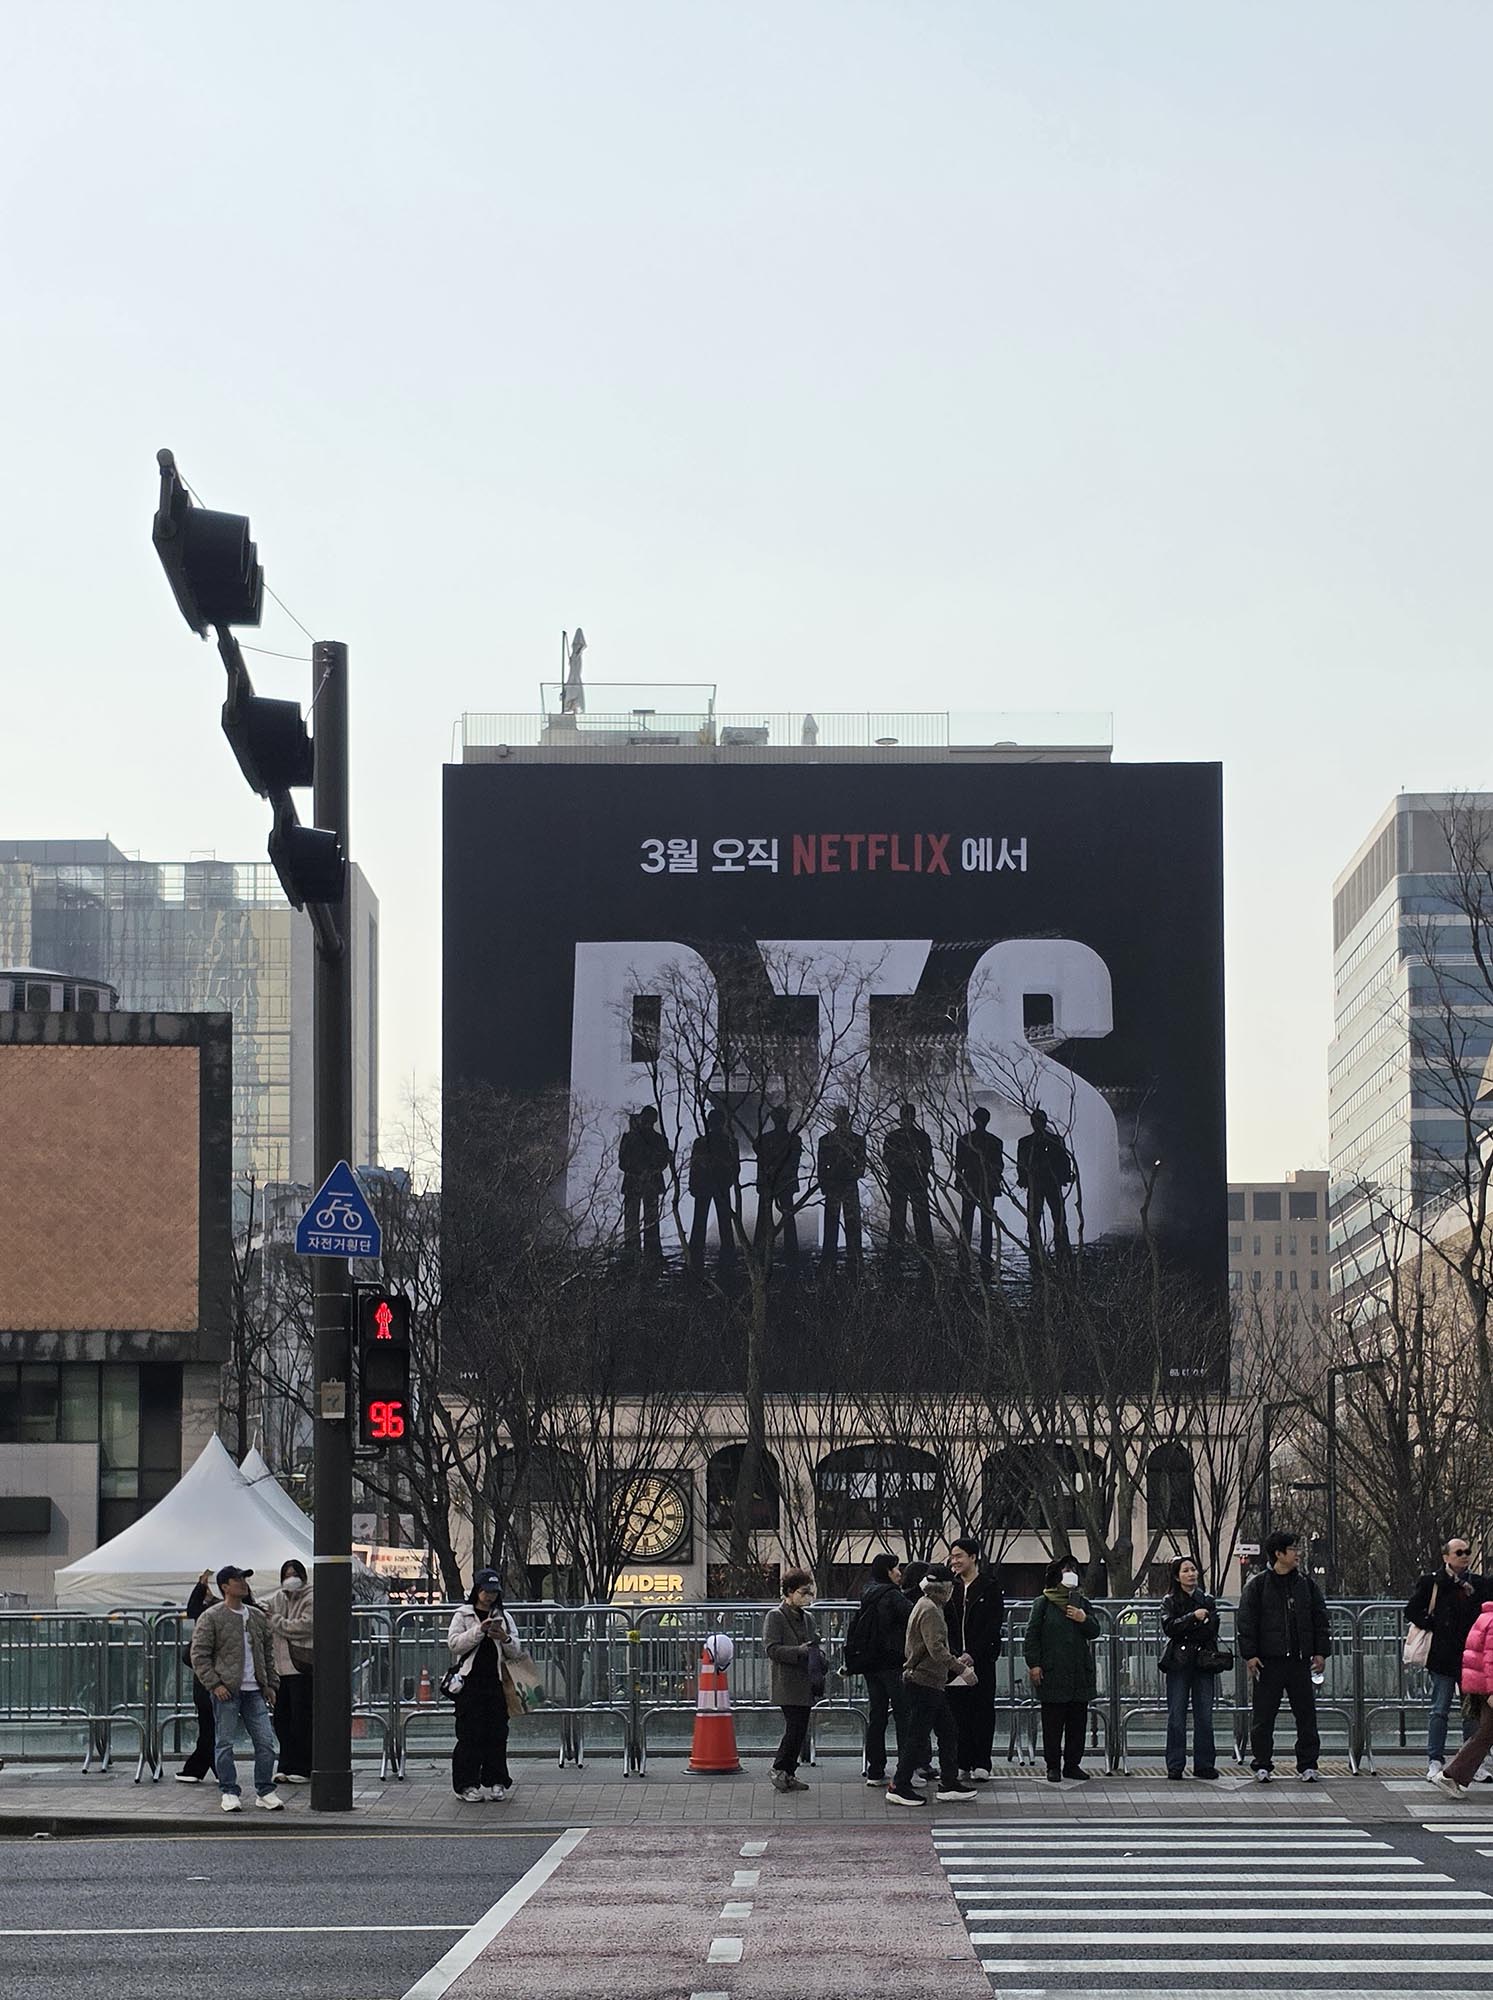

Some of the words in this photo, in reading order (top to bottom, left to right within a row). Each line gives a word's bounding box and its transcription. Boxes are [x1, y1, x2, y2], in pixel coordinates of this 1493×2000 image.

[640, 838, 698, 874] 3월
[711, 838, 779, 873] 오직
[792, 833, 952, 876] NETFLIX
[961, 837, 1028, 872] 에서
[307, 1236, 371, 1253] 자전거횡단
[368, 1401, 404, 1438] 96
